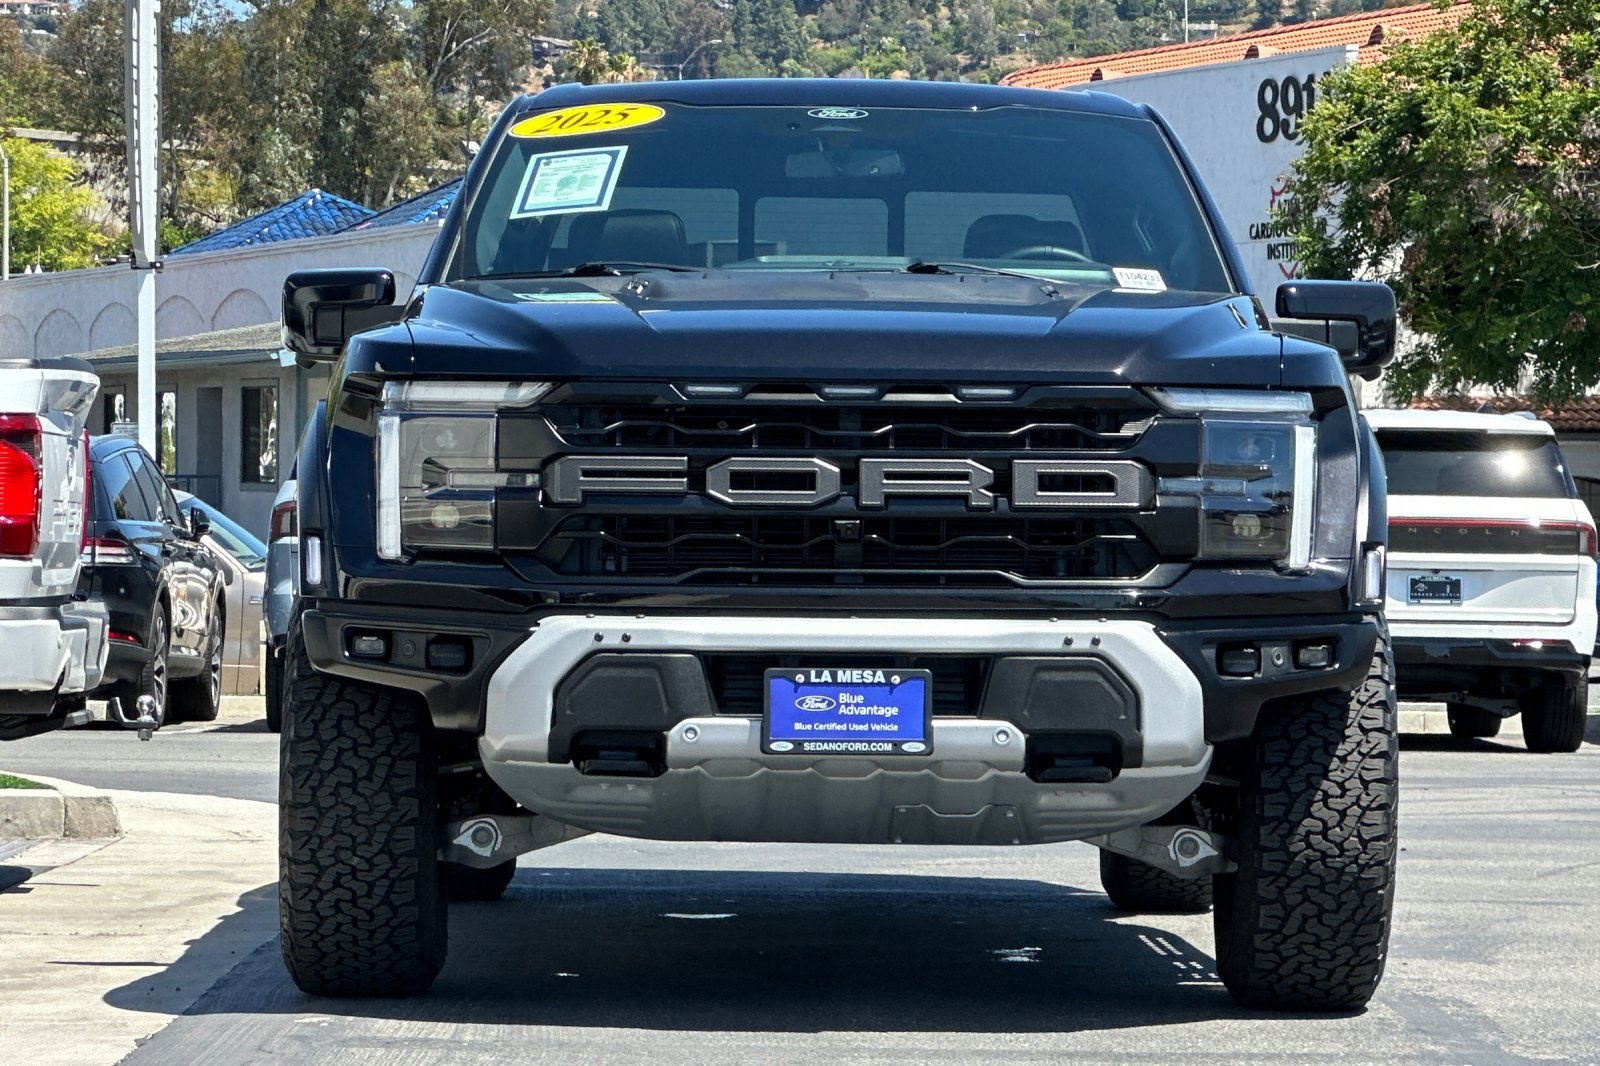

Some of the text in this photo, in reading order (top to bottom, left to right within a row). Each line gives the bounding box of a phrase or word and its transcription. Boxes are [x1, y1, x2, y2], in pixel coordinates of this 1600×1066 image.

[813, 107, 863, 118] Ford
[530, 107, 639, 135] 2025
[546, 455, 1147, 509] FORD
[810, 670, 886, 684] LA MESA
[799, 696, 832, 711] Ford
[838, 693, 864, 704] Blue
[838, 706, 899, 718] Advantage
[794, 722, 898, 732] Blue Certified Used Vehicle
[803, 742, 893, 752] SEDANOFORD.COM
